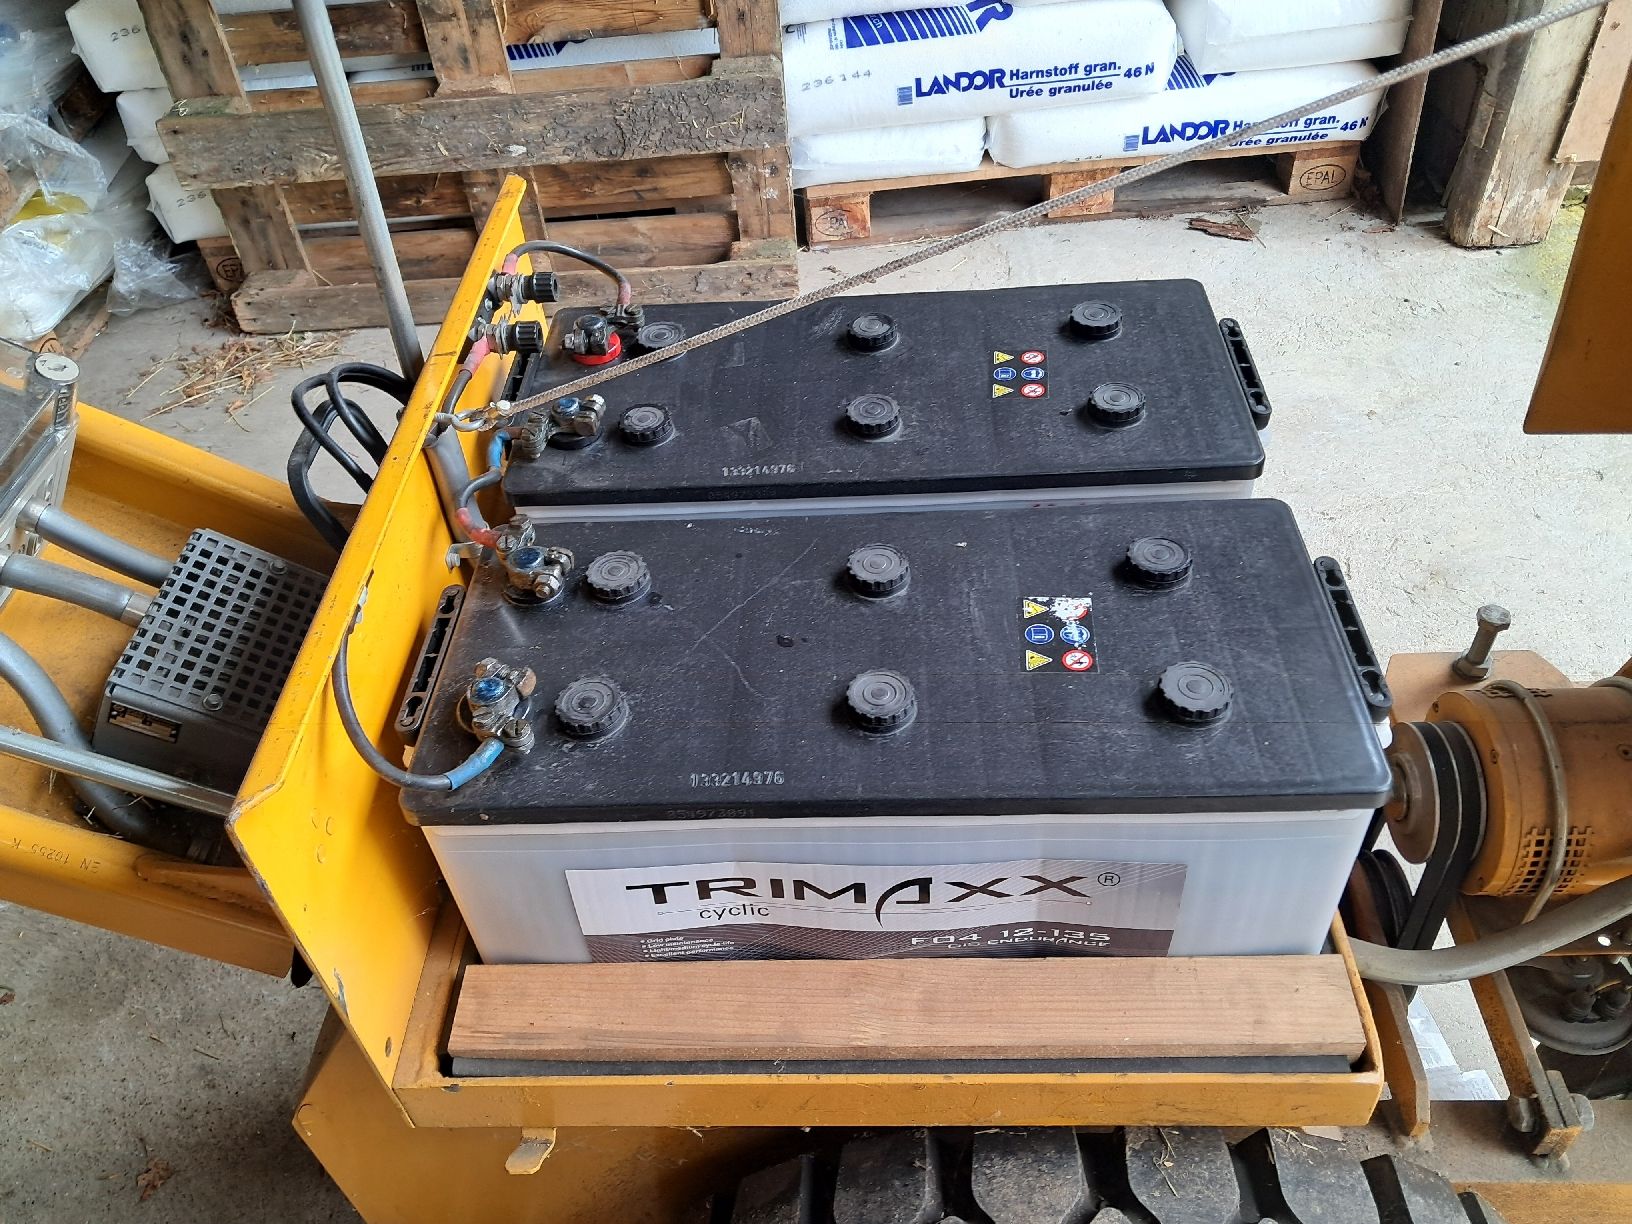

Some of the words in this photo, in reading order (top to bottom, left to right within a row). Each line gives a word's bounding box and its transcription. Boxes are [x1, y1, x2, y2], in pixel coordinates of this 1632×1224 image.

[1009, 63, 1079, 81] Harnstoff
[1084, 61, 1122, 76] gran.
[1123, 67, 1142, 79] 46
[1145, 62, 1155, 76] N
[915, 68, 1006, 98] LANDOR
[1009, 86, 1044, 99] Urée
[1048, 80, 1113, 97] granulée
[1304, 115, 1341, 128] gran.
[1340, 121, 1358, 132] 46
[1142, 119, 1231, 145] LANDOR
[1265, 132, 1329, 146] granulée
[625, 875, 1092, 928] TRIMAXX
[699, 903, 770, 921] cyclic
